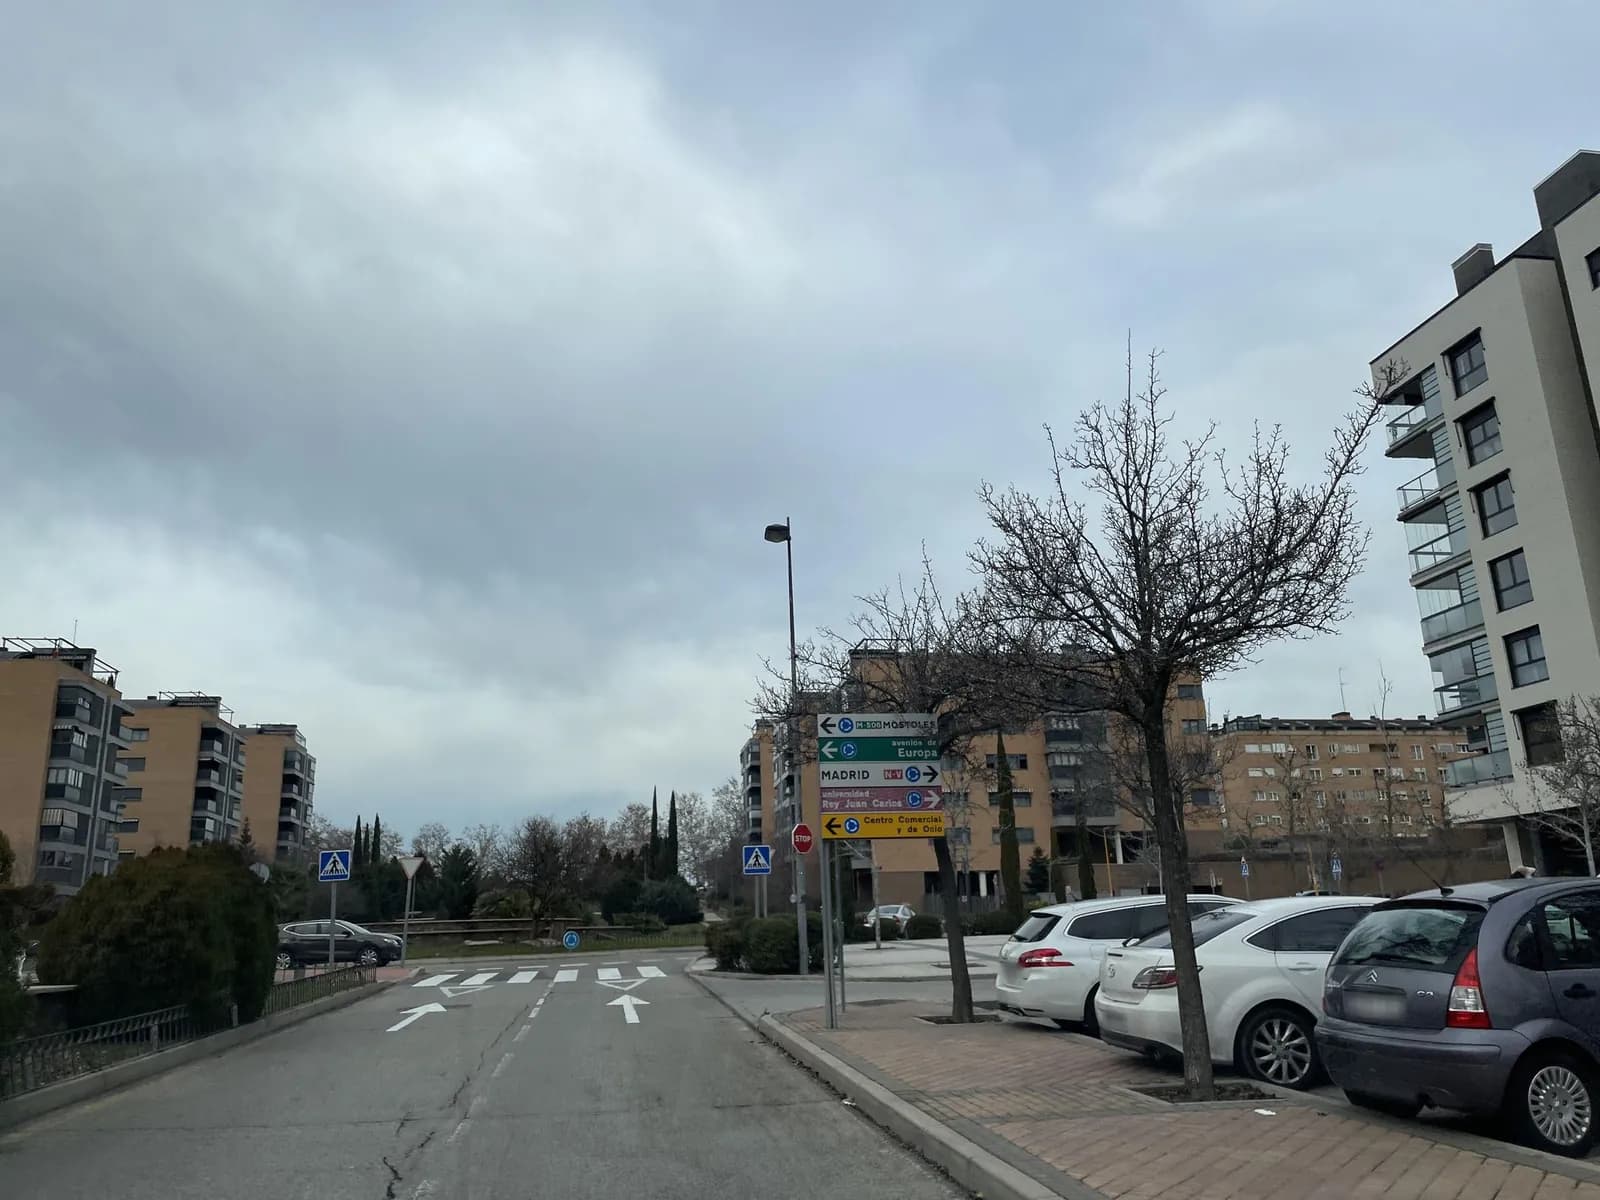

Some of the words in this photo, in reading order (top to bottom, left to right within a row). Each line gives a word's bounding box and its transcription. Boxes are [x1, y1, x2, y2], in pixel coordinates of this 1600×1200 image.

[898, 748, 938, 759] Europa
[821, 770, 870, 780] MADRID
[885, 769, 903, 779] N-V
[822, 790, 870, 798] universidad
[822, 799, 840, 809] Rey
[845, 799, 868, 808] Juan
[872, 799, 903, 808] Carlos
[863, 816, 894, 824] Centro
[898, 815, 942, 824] Comercial
[907, 825, 918, 833] de
[922, 825, 943, 833] Ocio
[795, 834, 811, 843] STOP
